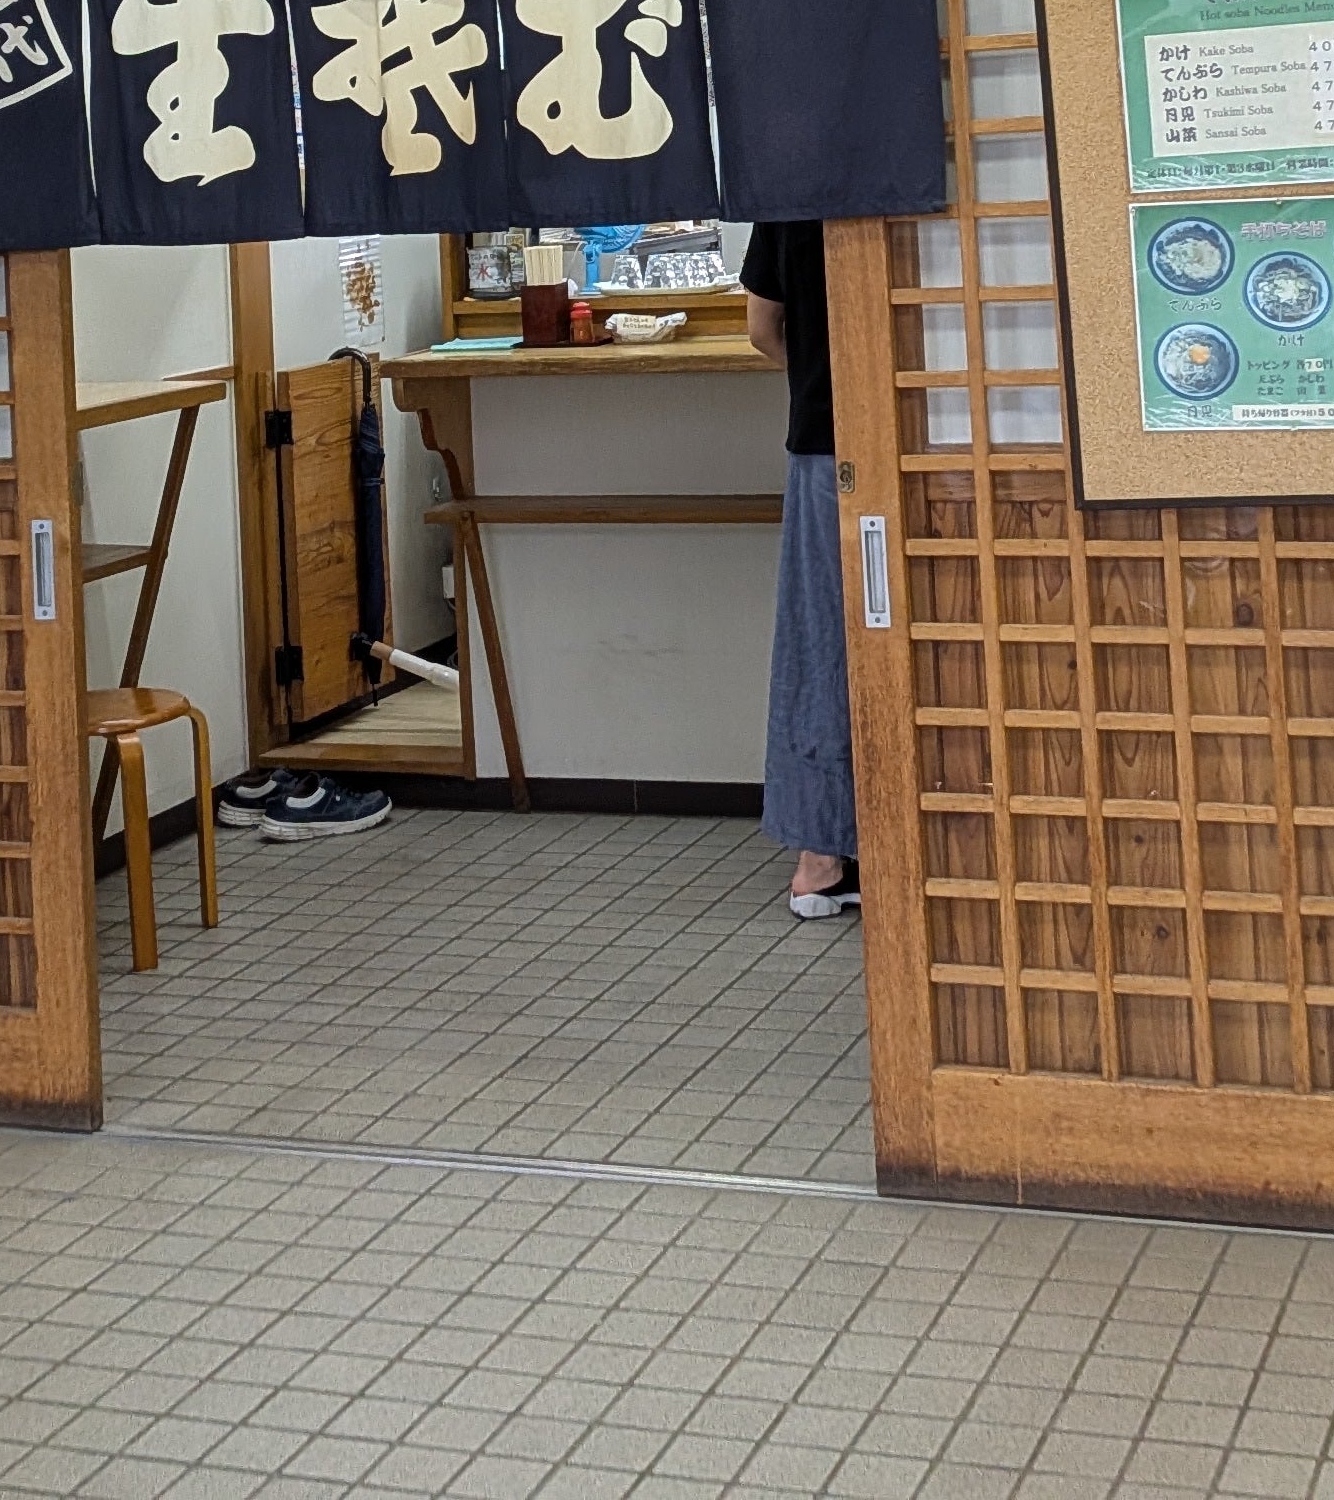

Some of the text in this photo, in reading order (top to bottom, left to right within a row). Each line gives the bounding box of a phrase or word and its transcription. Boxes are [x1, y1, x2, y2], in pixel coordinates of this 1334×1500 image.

[1159, 46, 1191, 62] かけ
[1199, 46, 1226, 57] Kake
[1228, 44, 1254, 55] Soba
[1230, 63, 1277, 76] Tempura
[1280, 61, 1306, 72] Soba
[1162, 85, 1208, 103] かしわ
[1216, 85, 1258, 97] Kashiwa
[1261, 82, 1287, 94] Soba
[1165, 106, 1196, 123] 月見
[1203, 106, 1245, 119] Tsukimi
[1247, 104, 1274, 115] Soba
[1205, 127, 1239, 139] Sansai
[1240, 125, 1267, 137] Soba
[1277, 334, 1304, 347] かけ
